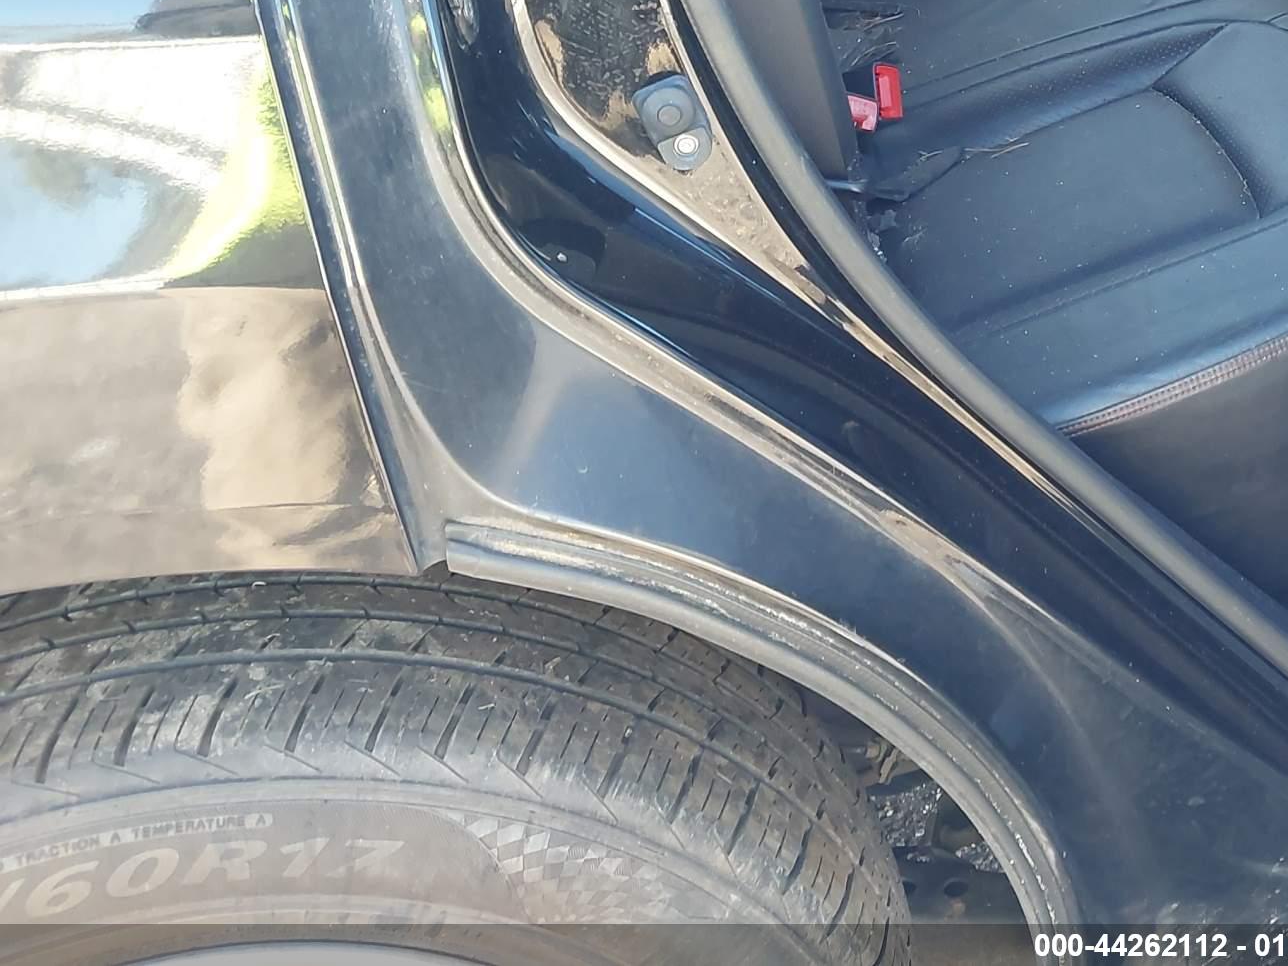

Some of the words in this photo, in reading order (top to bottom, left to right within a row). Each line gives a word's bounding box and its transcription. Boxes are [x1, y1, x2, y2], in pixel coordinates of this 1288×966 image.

[16, 837, 99, 867] TRACTION
[131, 815, 245, 840] TEMPERATURE
[256, 813, 267, 826] A
